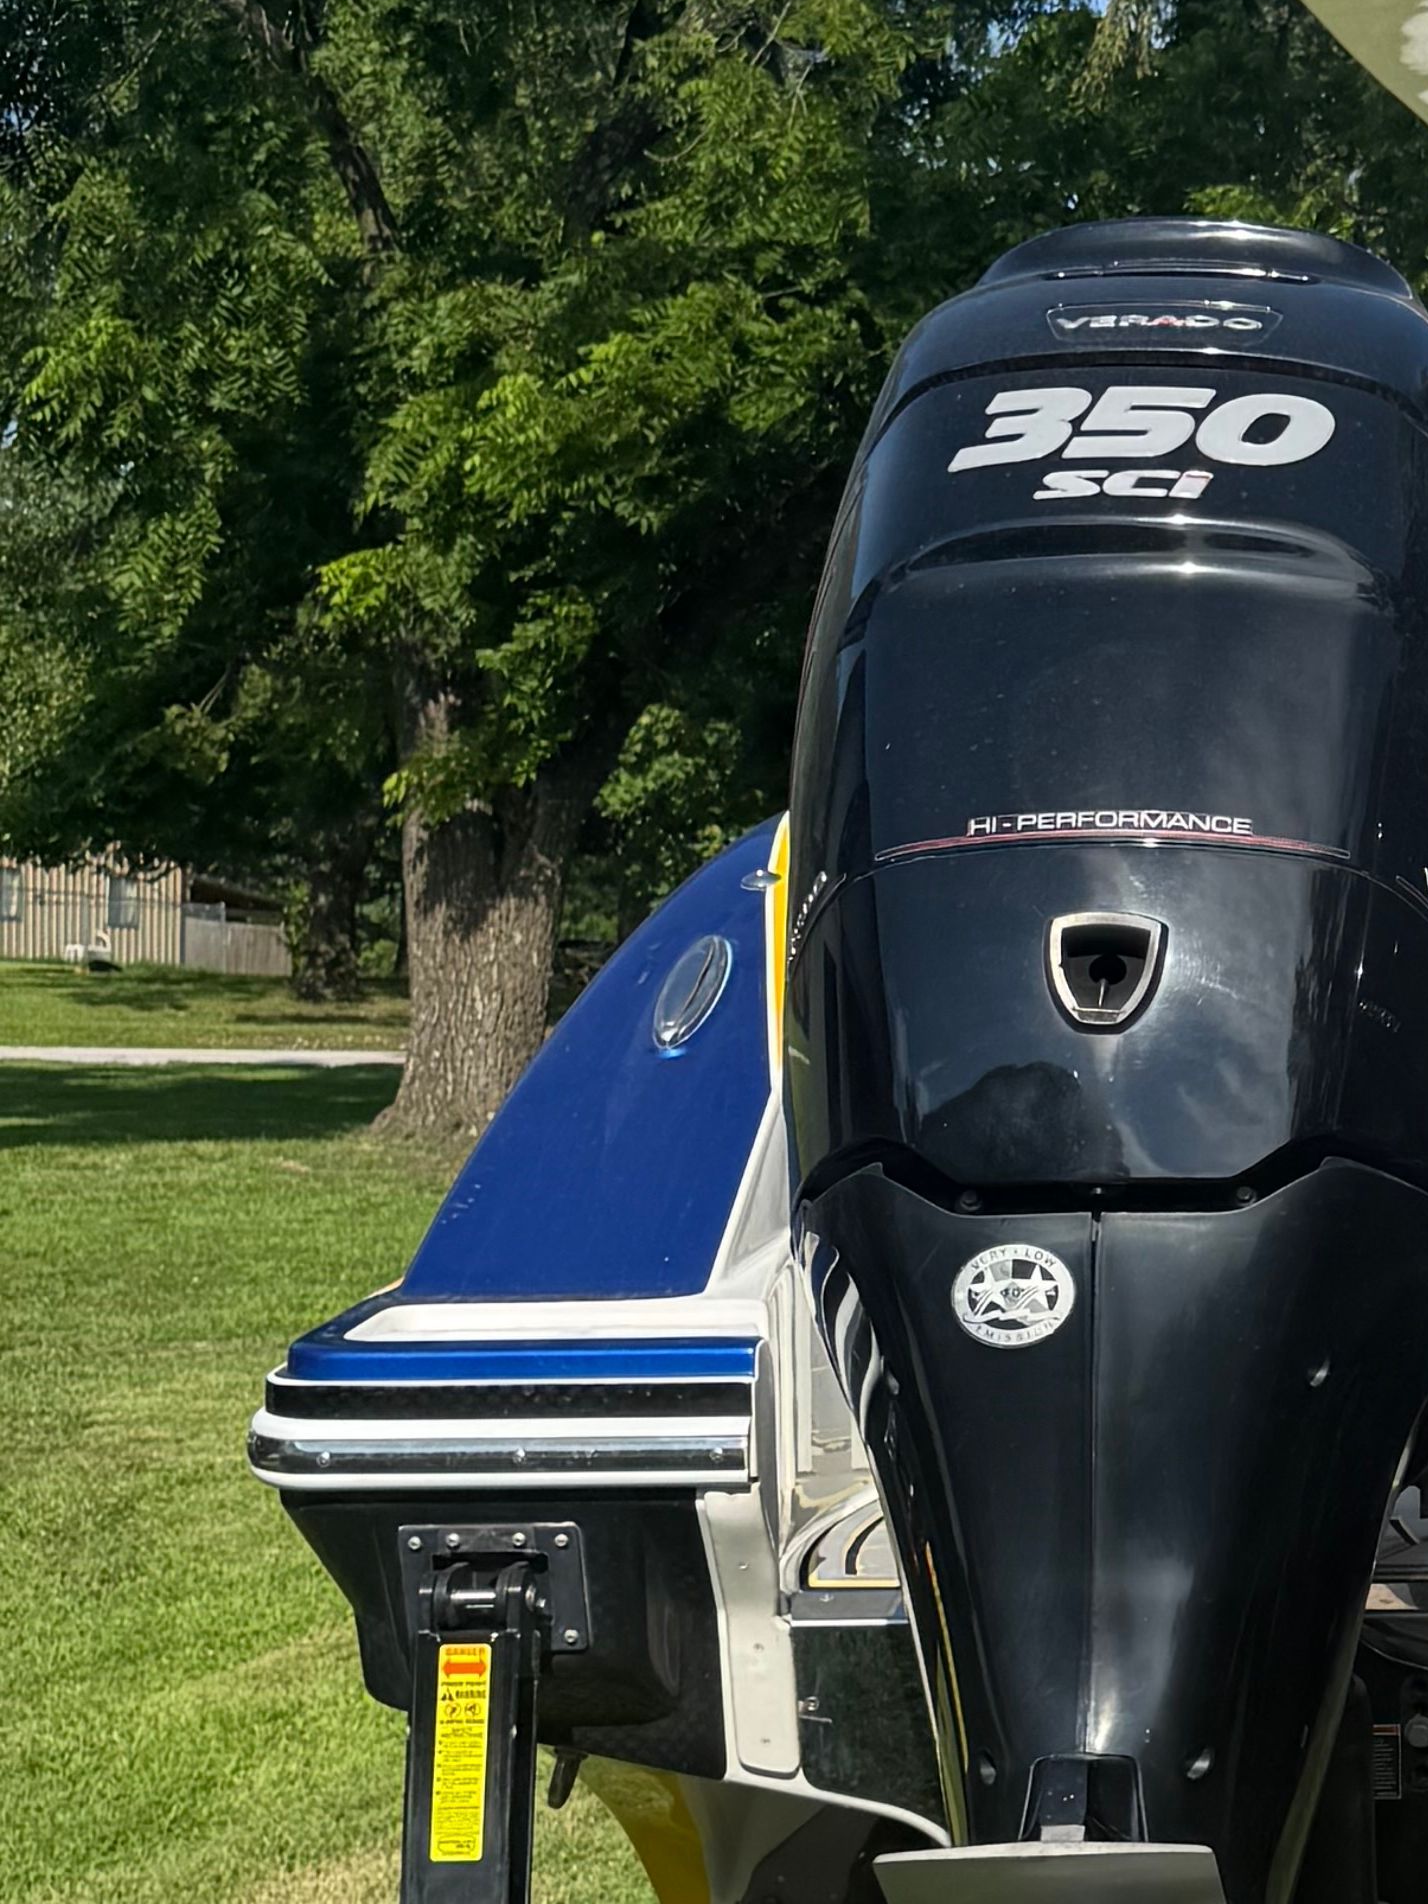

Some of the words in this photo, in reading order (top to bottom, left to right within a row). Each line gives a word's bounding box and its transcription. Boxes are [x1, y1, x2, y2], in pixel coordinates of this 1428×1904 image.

[1056, 314, 1263, 330] VERADO
[947, 386, 1336, 472] 350
[1024, 1247, 1057, 1267] LOW
